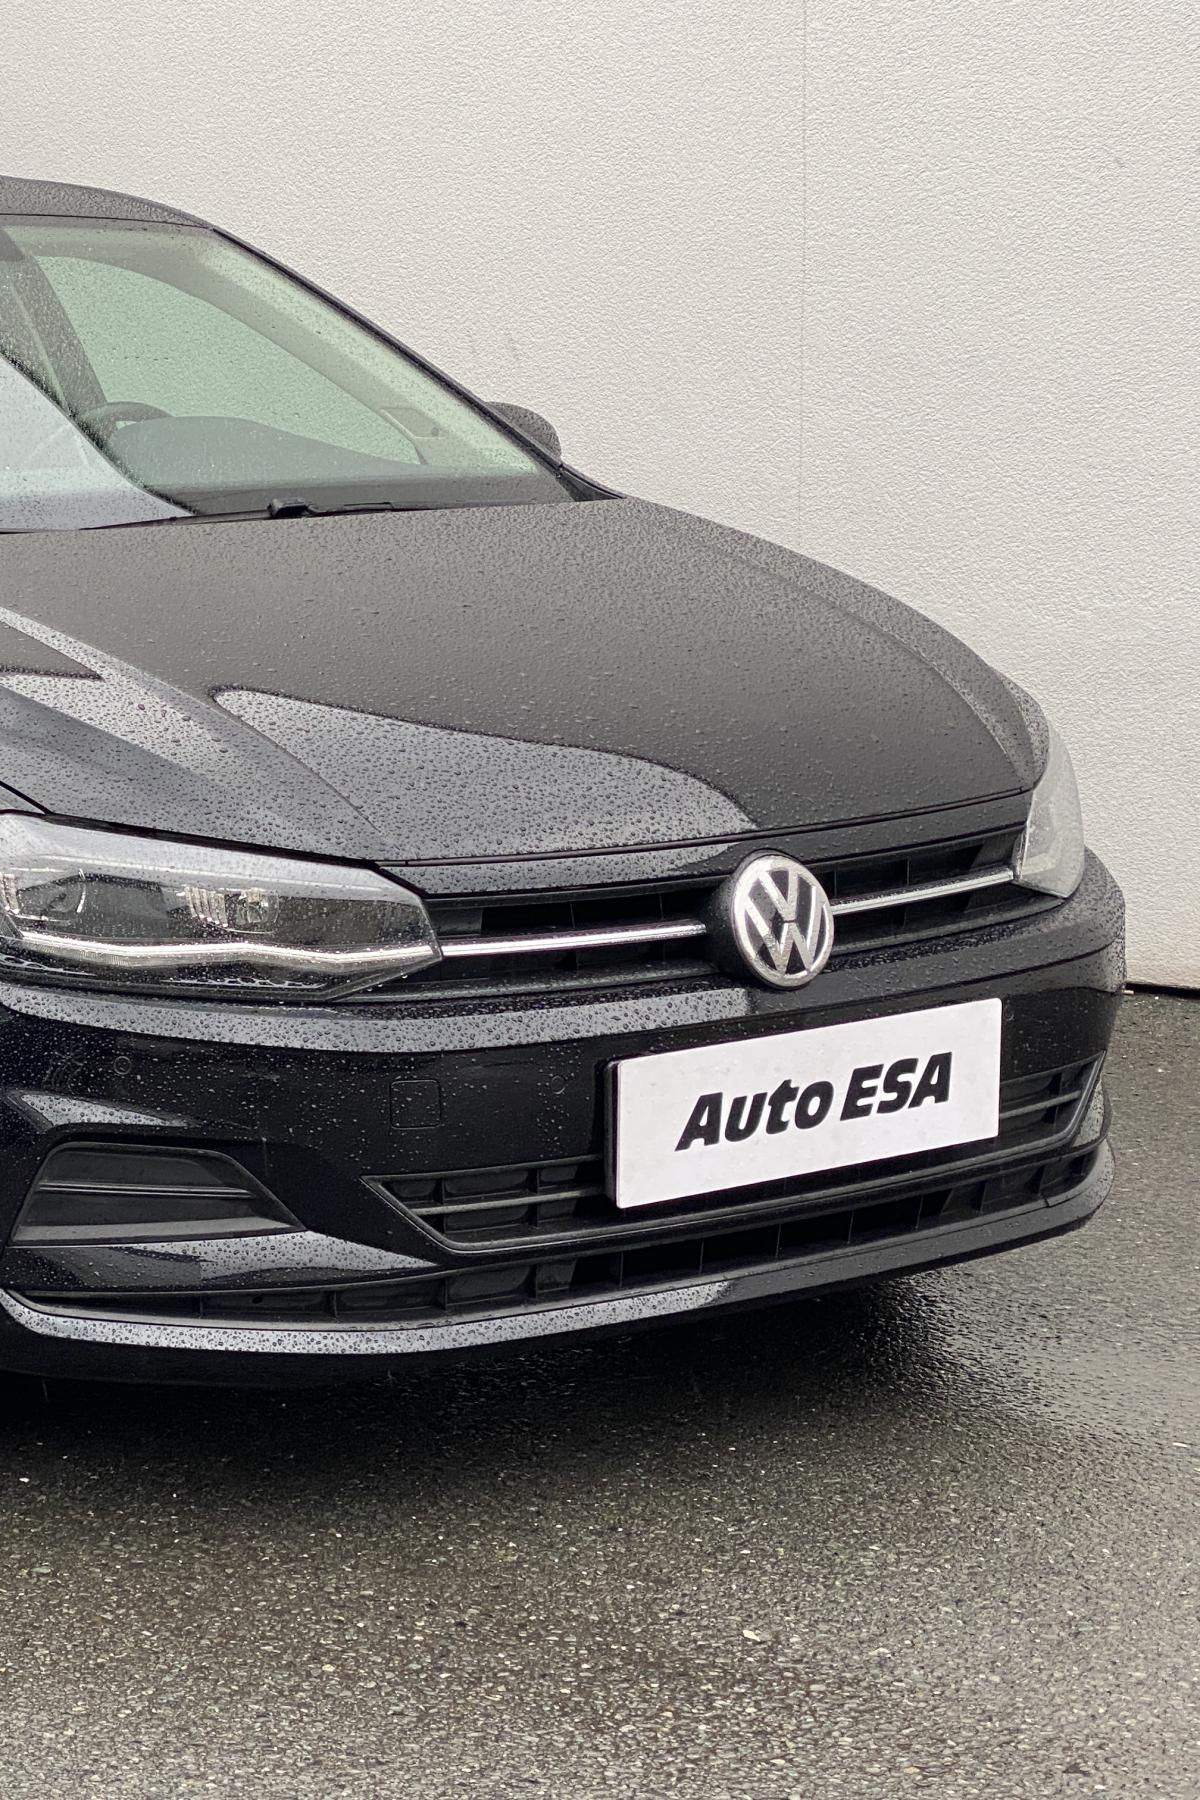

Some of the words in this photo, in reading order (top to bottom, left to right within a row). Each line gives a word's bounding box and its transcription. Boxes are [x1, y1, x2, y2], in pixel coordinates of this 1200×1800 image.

[733, 854, 834, 987] VW
[674, 1079, 834, 1152] Auto
[840, 1051, 952, 1122] ESA
